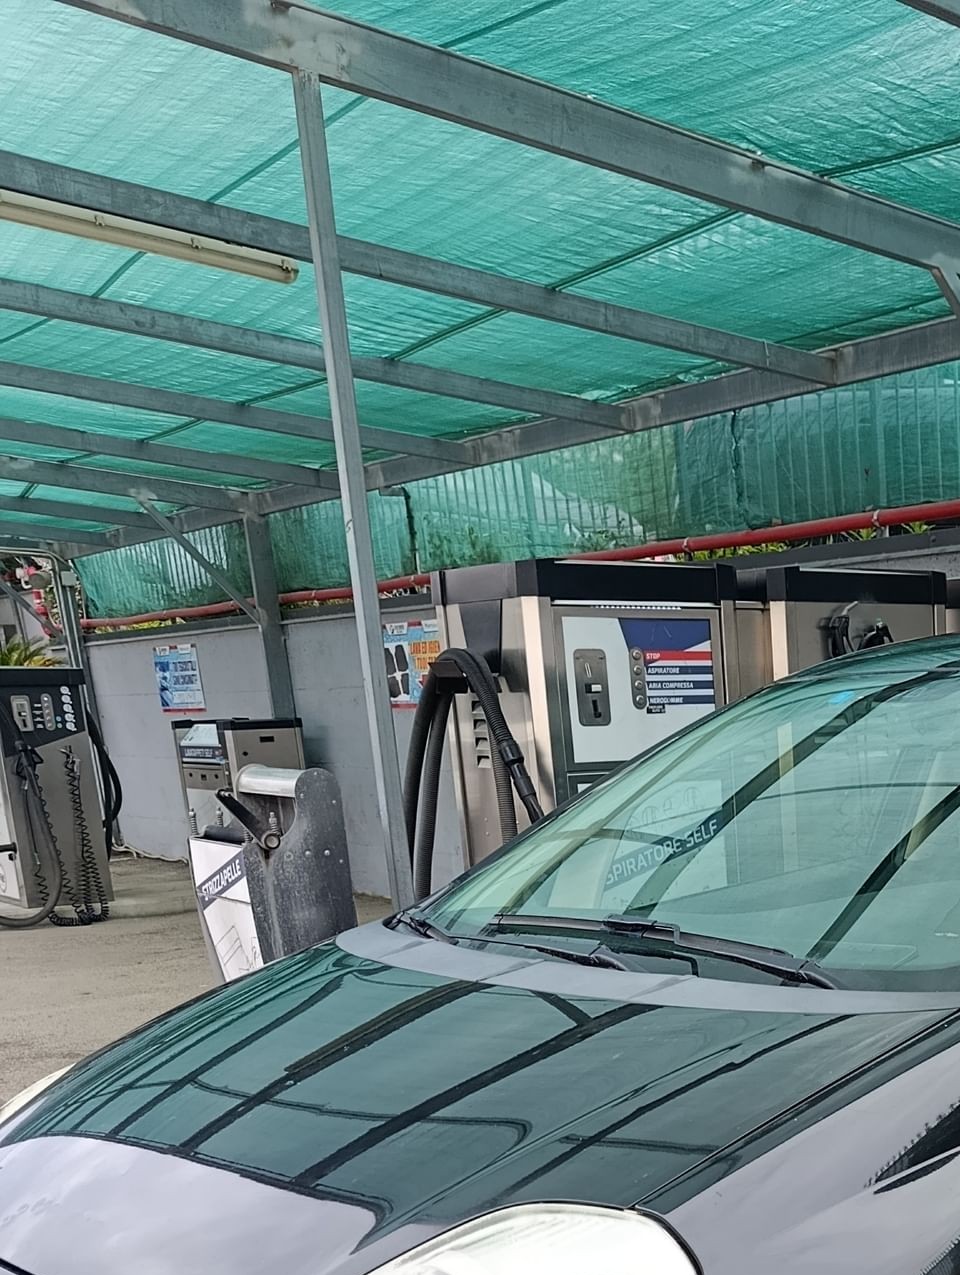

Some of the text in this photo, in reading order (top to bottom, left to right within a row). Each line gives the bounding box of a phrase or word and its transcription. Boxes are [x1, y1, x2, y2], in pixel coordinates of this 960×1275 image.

[606, 820, 718, 885] SPIRATORE SELF
[201, 859, 242, 901] STRIZZAPELLE
